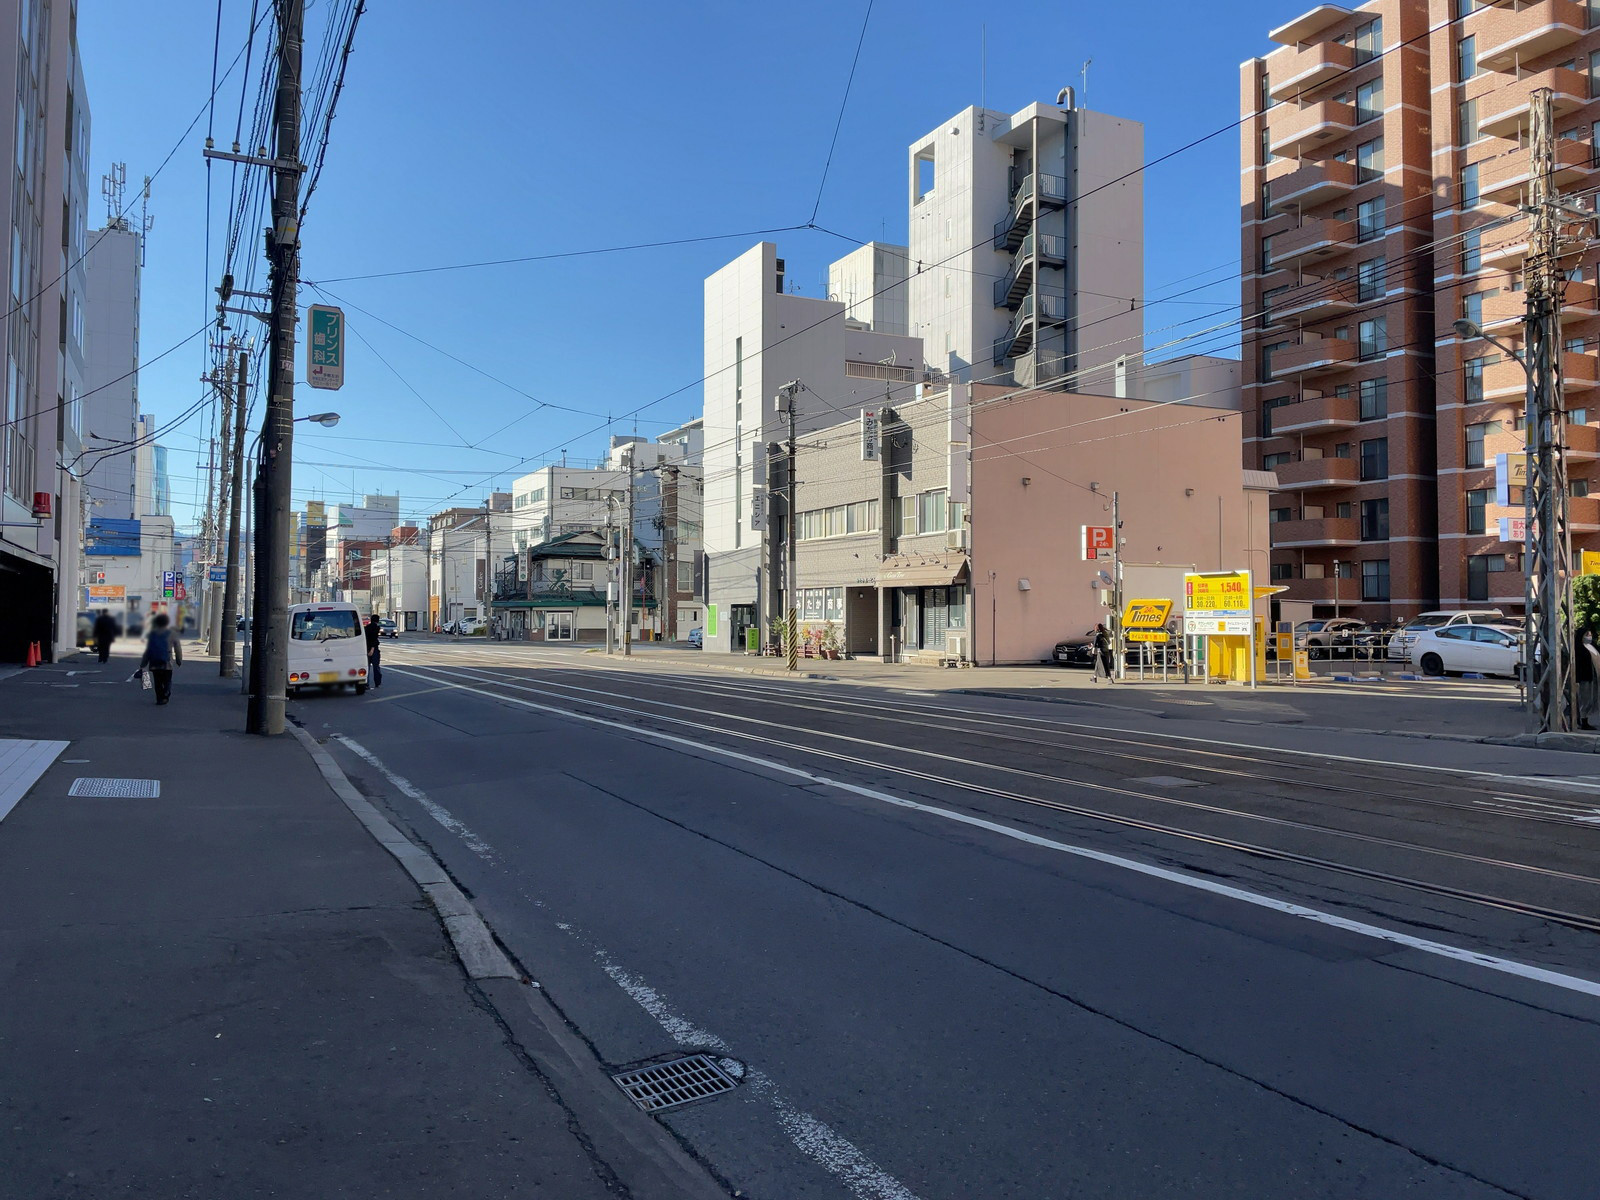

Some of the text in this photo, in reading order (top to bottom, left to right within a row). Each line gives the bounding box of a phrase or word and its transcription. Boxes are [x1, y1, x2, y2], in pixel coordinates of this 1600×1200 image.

[314, 332, 326, 363] 歯科
[326, 314, 339, 365] プリンス
[1092, 528, 1107, 546] P
[1131, 608, 1162, 623] Times
